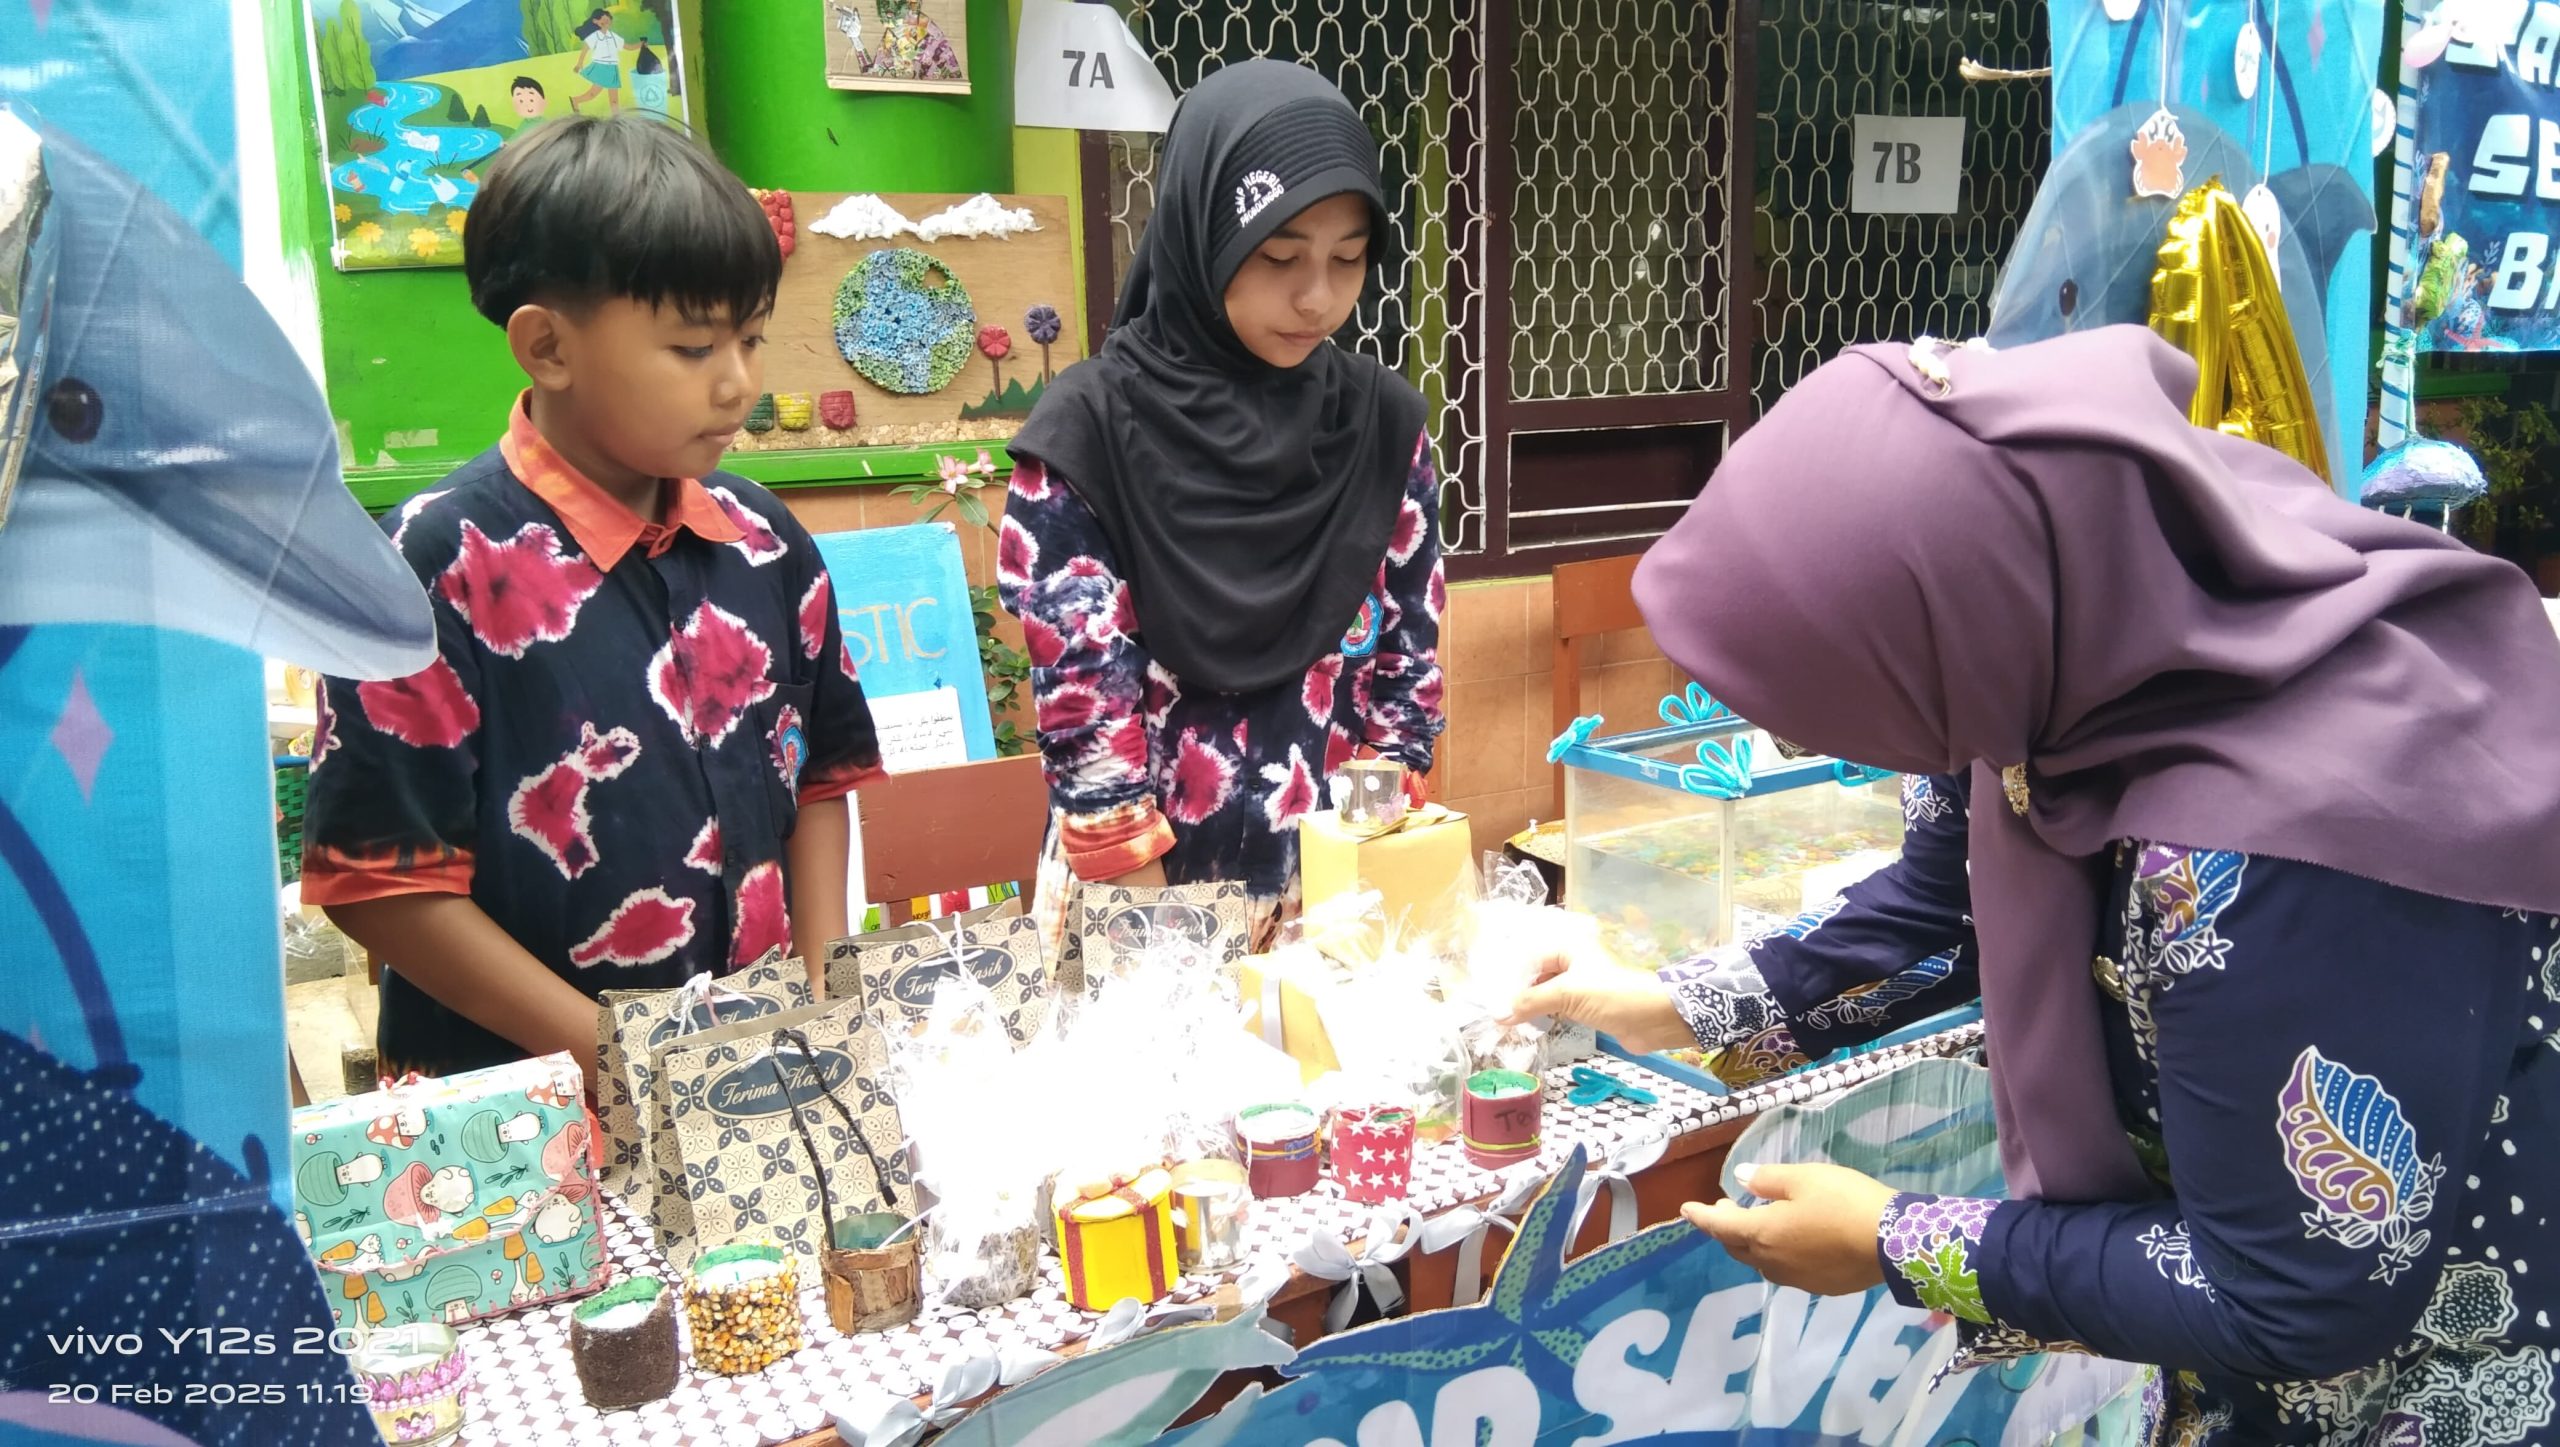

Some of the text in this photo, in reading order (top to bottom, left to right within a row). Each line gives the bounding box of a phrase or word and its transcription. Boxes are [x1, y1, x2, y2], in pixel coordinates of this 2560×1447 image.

[1062, 50, 1115, 89] 7A
[1872, 141, 1921, 184] 7B
[1235, 169, 1281, 215] SMP NEGERI
[1250, 186, 1262, 203] 2
[718, 1080, 780, 1109] Terima
